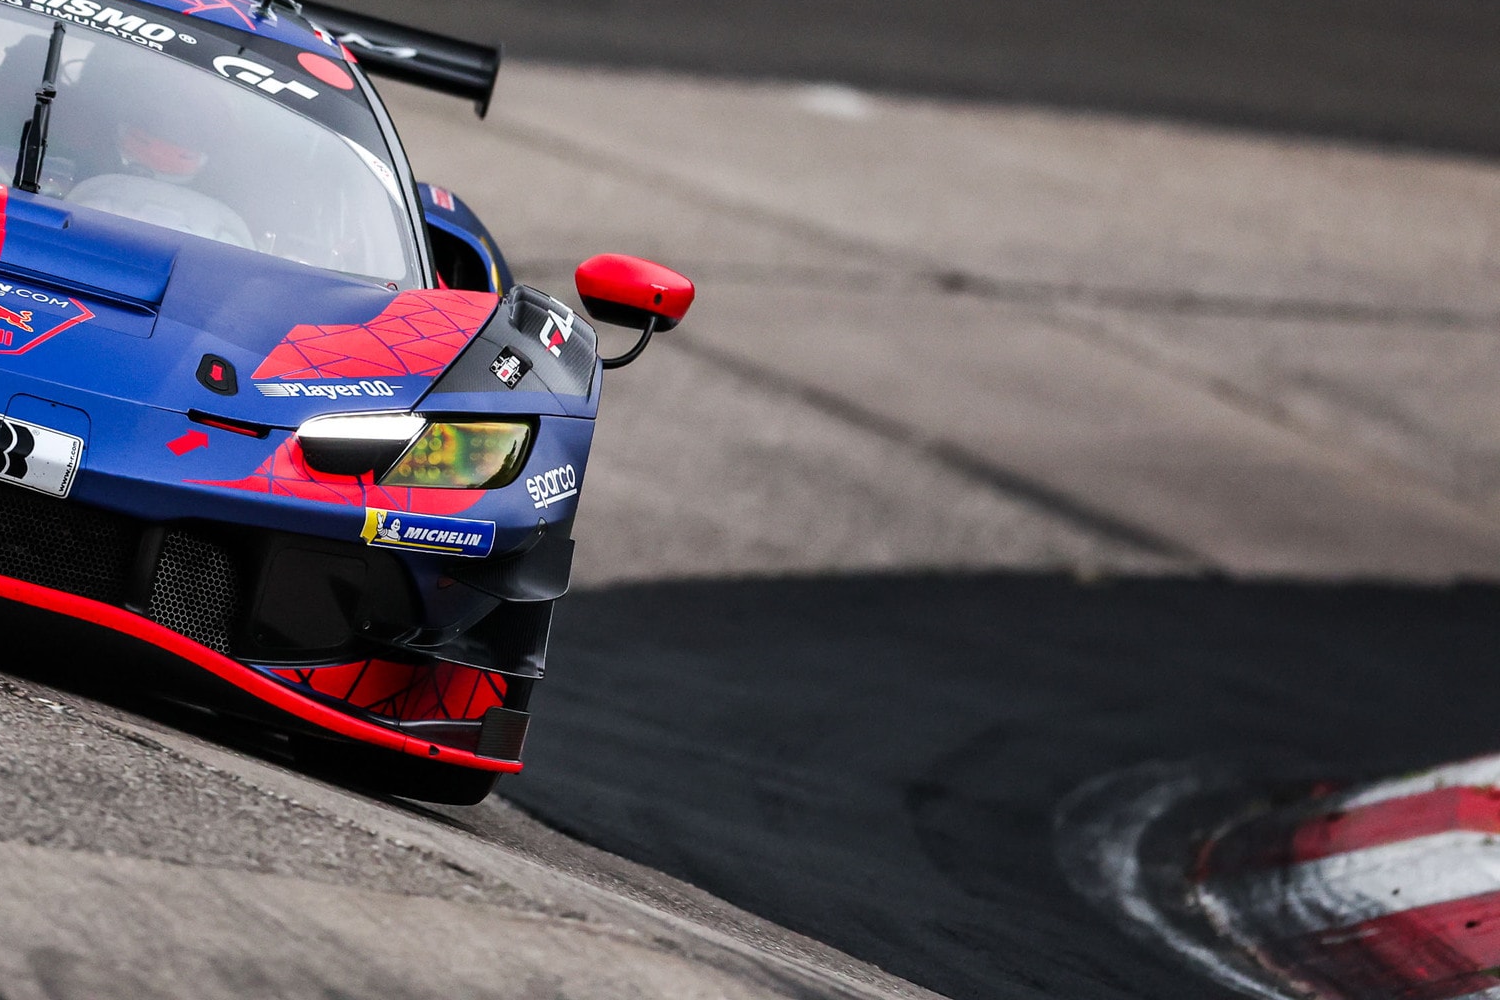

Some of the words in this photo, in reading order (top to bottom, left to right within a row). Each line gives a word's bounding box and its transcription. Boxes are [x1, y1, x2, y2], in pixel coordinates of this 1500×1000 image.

[29, 2, 165, 52] SIMULATOR
[58, 441, 78, 492] www.h-r.com
[526, 463, 577, 508] sparco
[403, 525, 483, 547] MICHELIN
